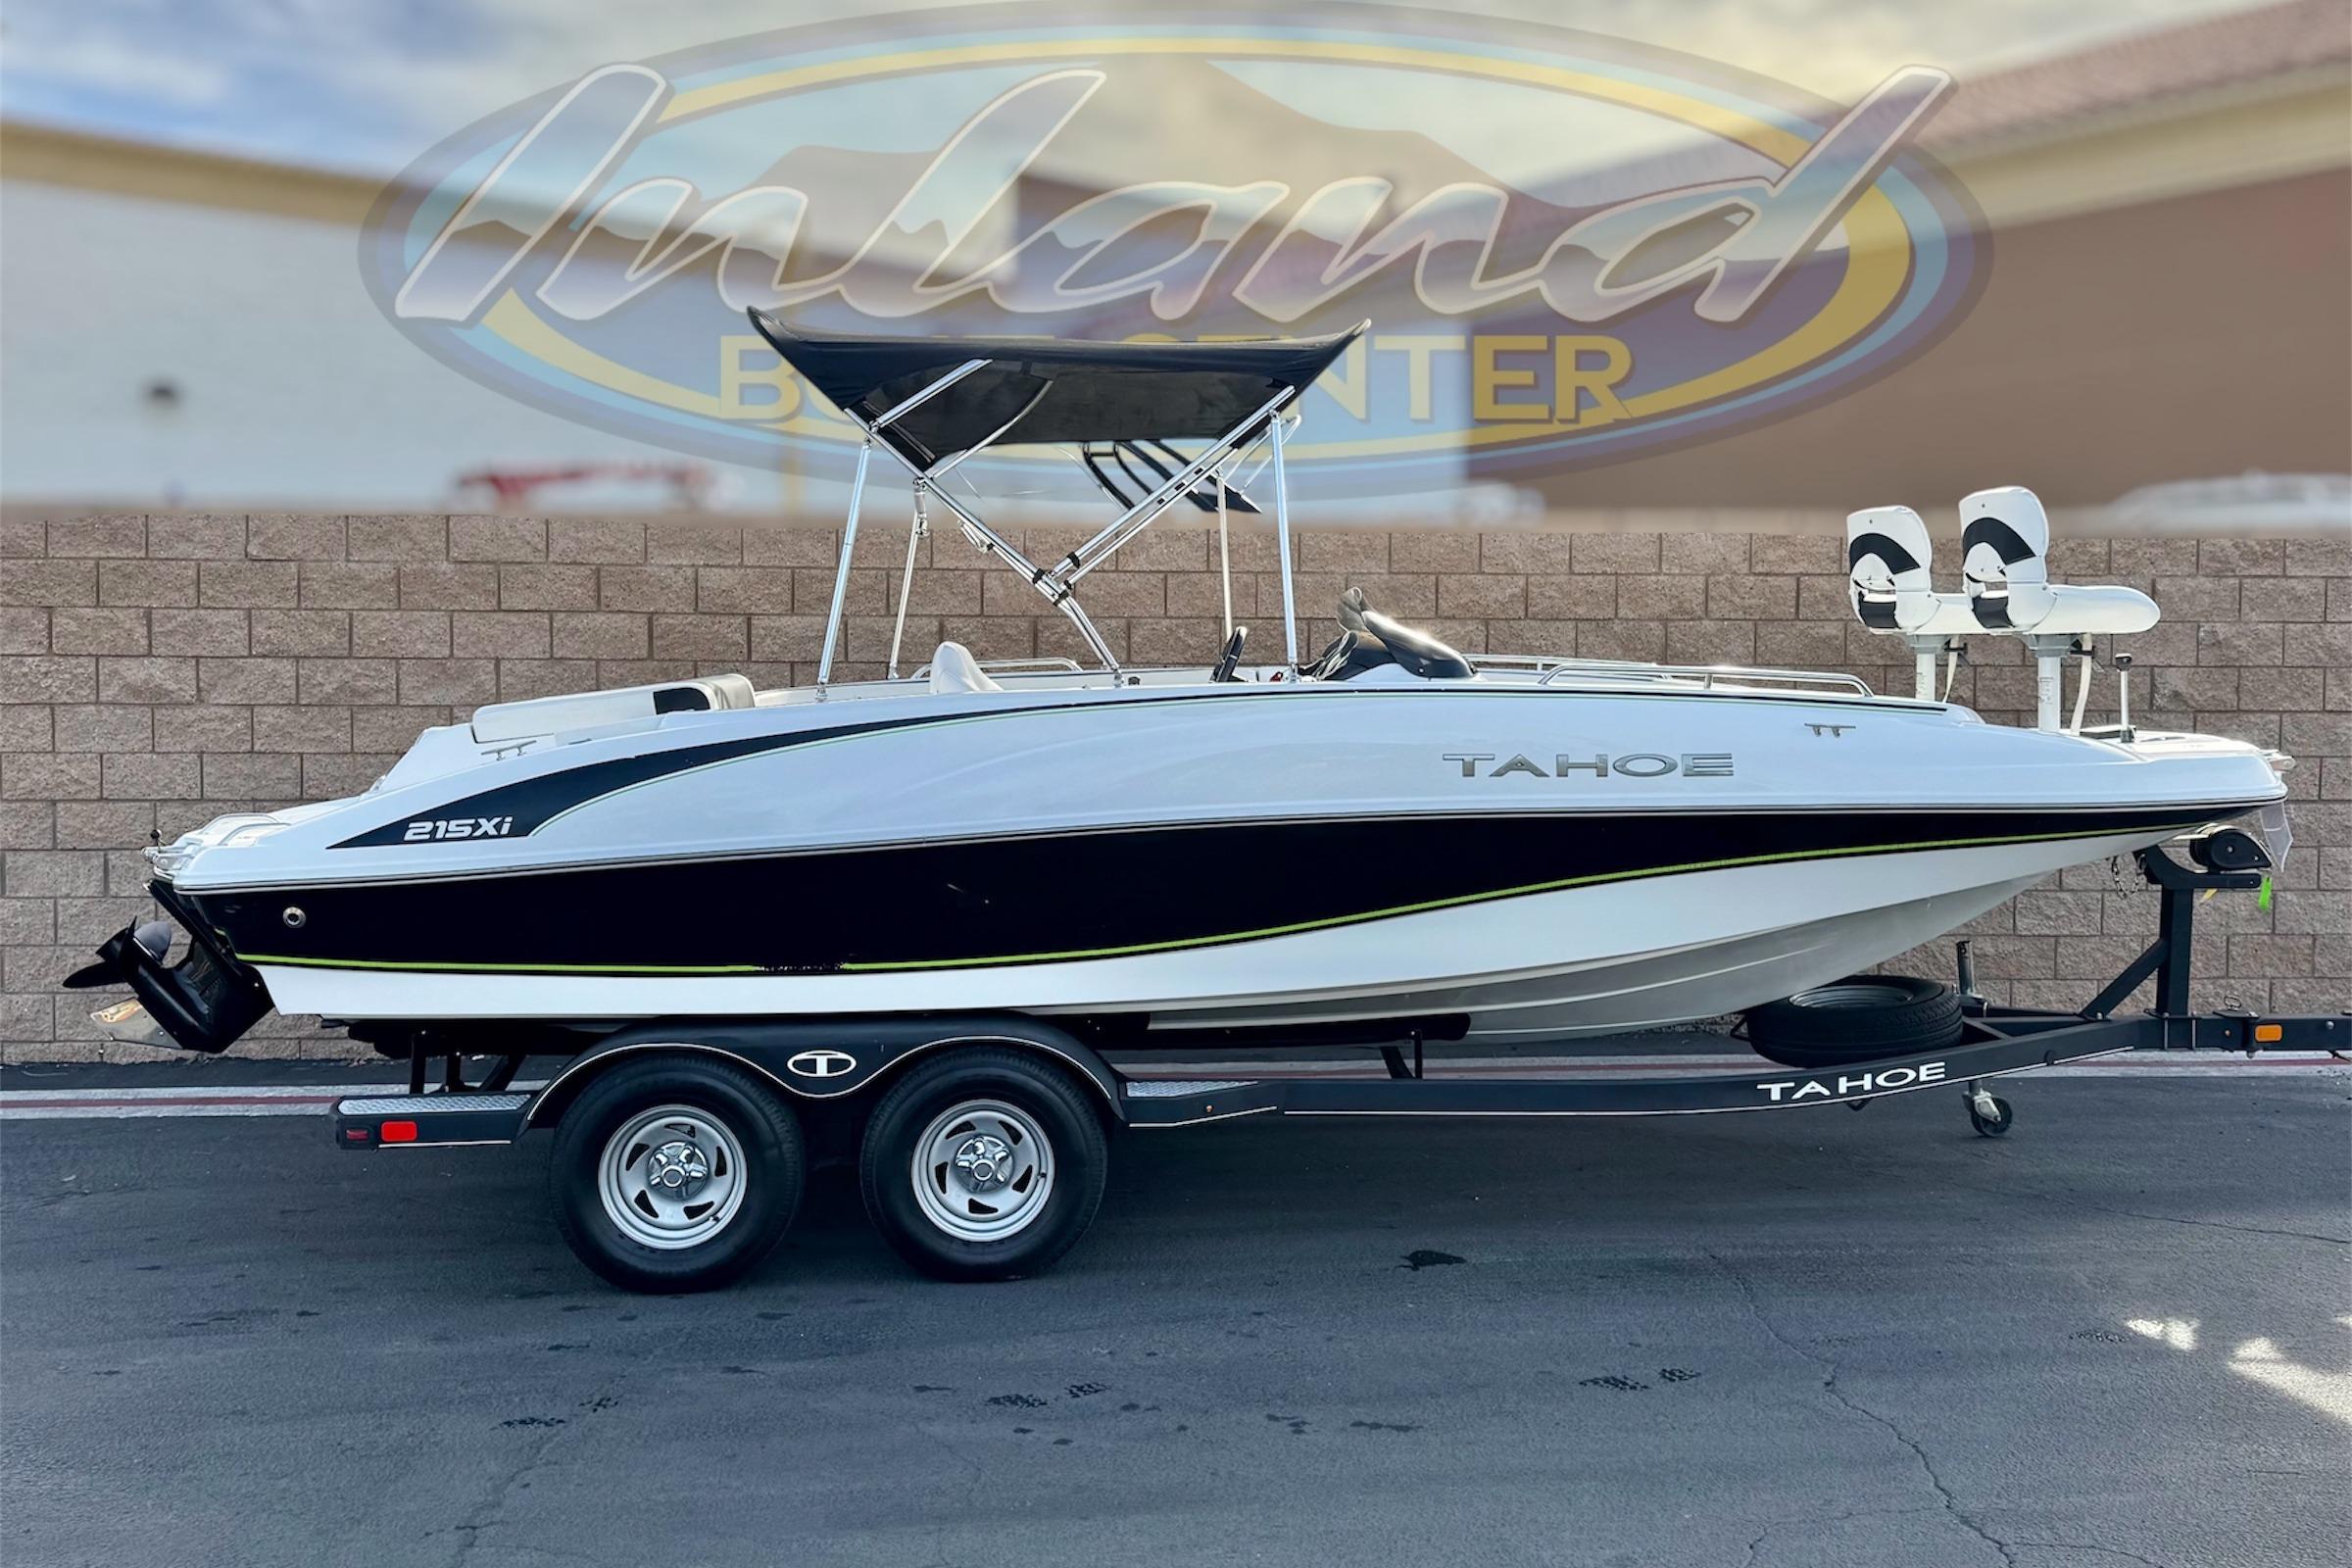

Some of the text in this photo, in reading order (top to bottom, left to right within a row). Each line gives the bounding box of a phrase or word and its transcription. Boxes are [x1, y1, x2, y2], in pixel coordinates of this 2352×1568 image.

[1443, 753, 1734, 777] TAHOE
[403, 815, 514, 841] 215Xi
[1756, 1061, 1945, 1102] TAHOE
